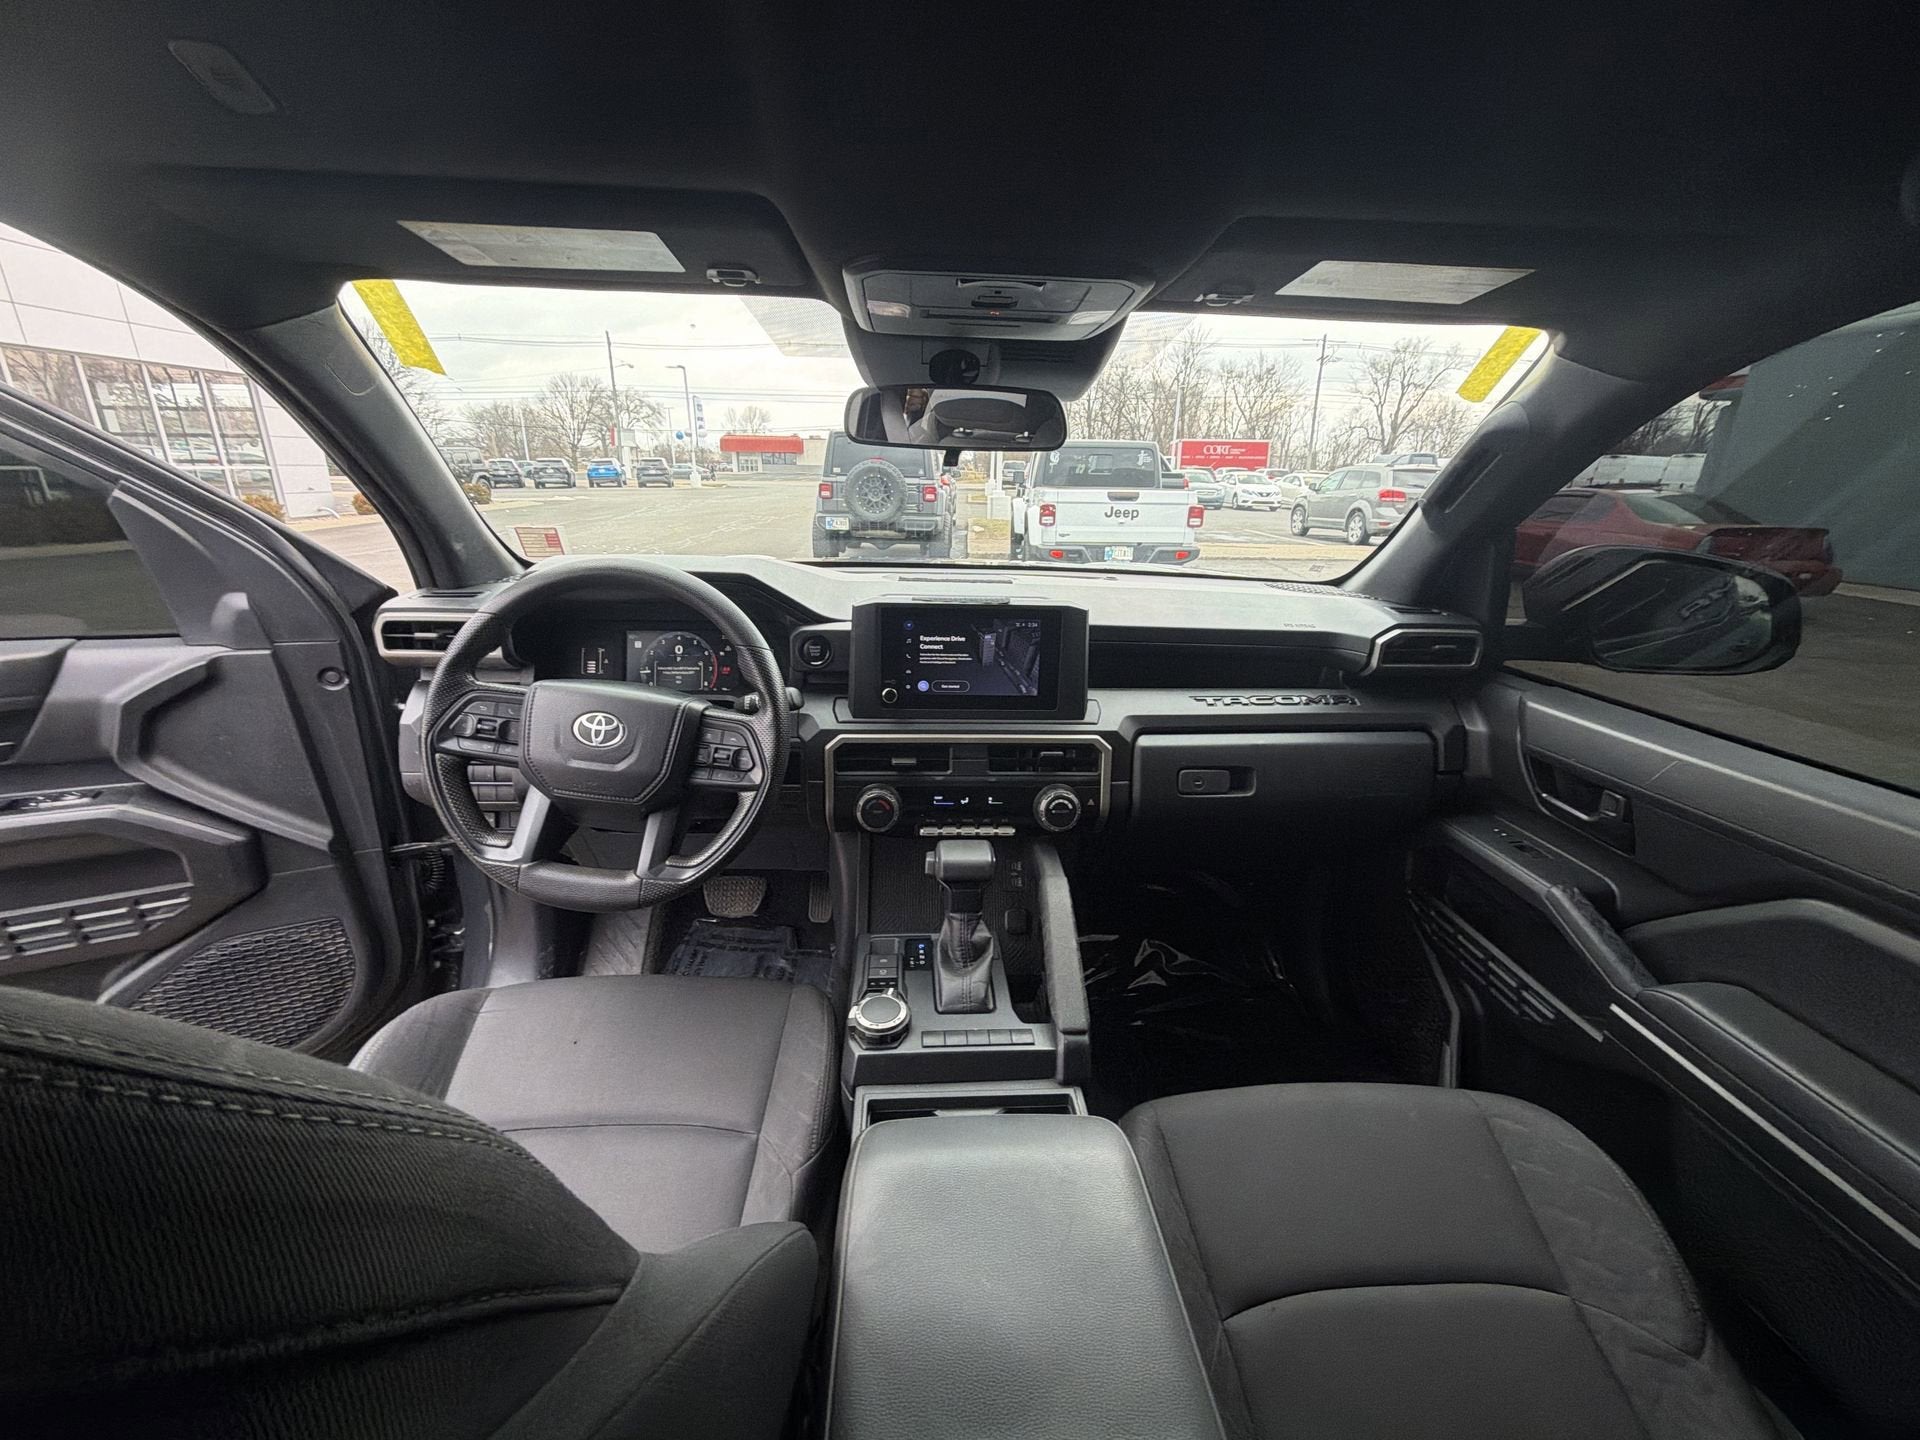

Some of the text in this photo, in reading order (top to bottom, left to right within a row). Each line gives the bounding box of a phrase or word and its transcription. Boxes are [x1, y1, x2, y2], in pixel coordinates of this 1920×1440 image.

[1203, 444, 1232, 455] CORT
[1104, 506, 1140, 521] Jeep
[674, 645, 683, 655] 0
[1190, 695, 1361, 706] TACOMA
